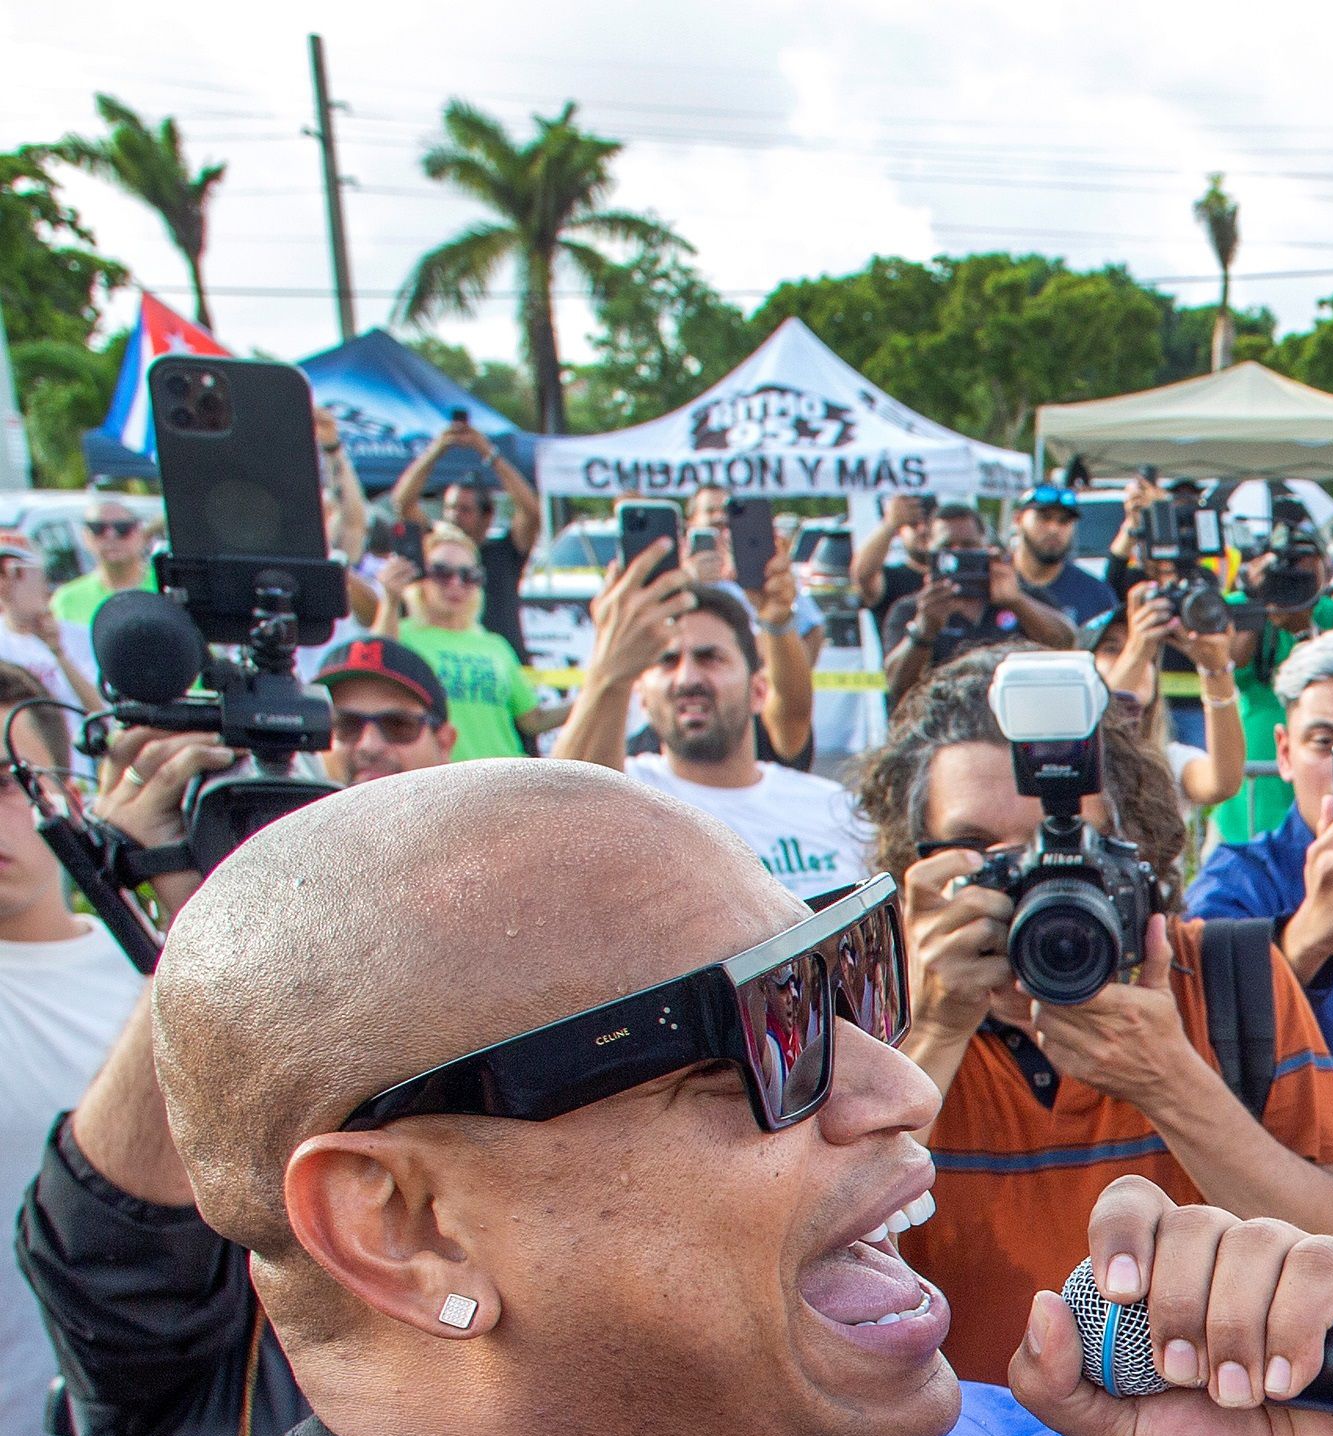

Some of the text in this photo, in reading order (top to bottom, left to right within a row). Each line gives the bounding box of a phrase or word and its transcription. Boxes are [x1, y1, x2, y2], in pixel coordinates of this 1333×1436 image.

[796, 455, 822, 487] Y
[1042, 853, 1084, 866] Nikon
[595, 1027, 631, 1046] CELINE
